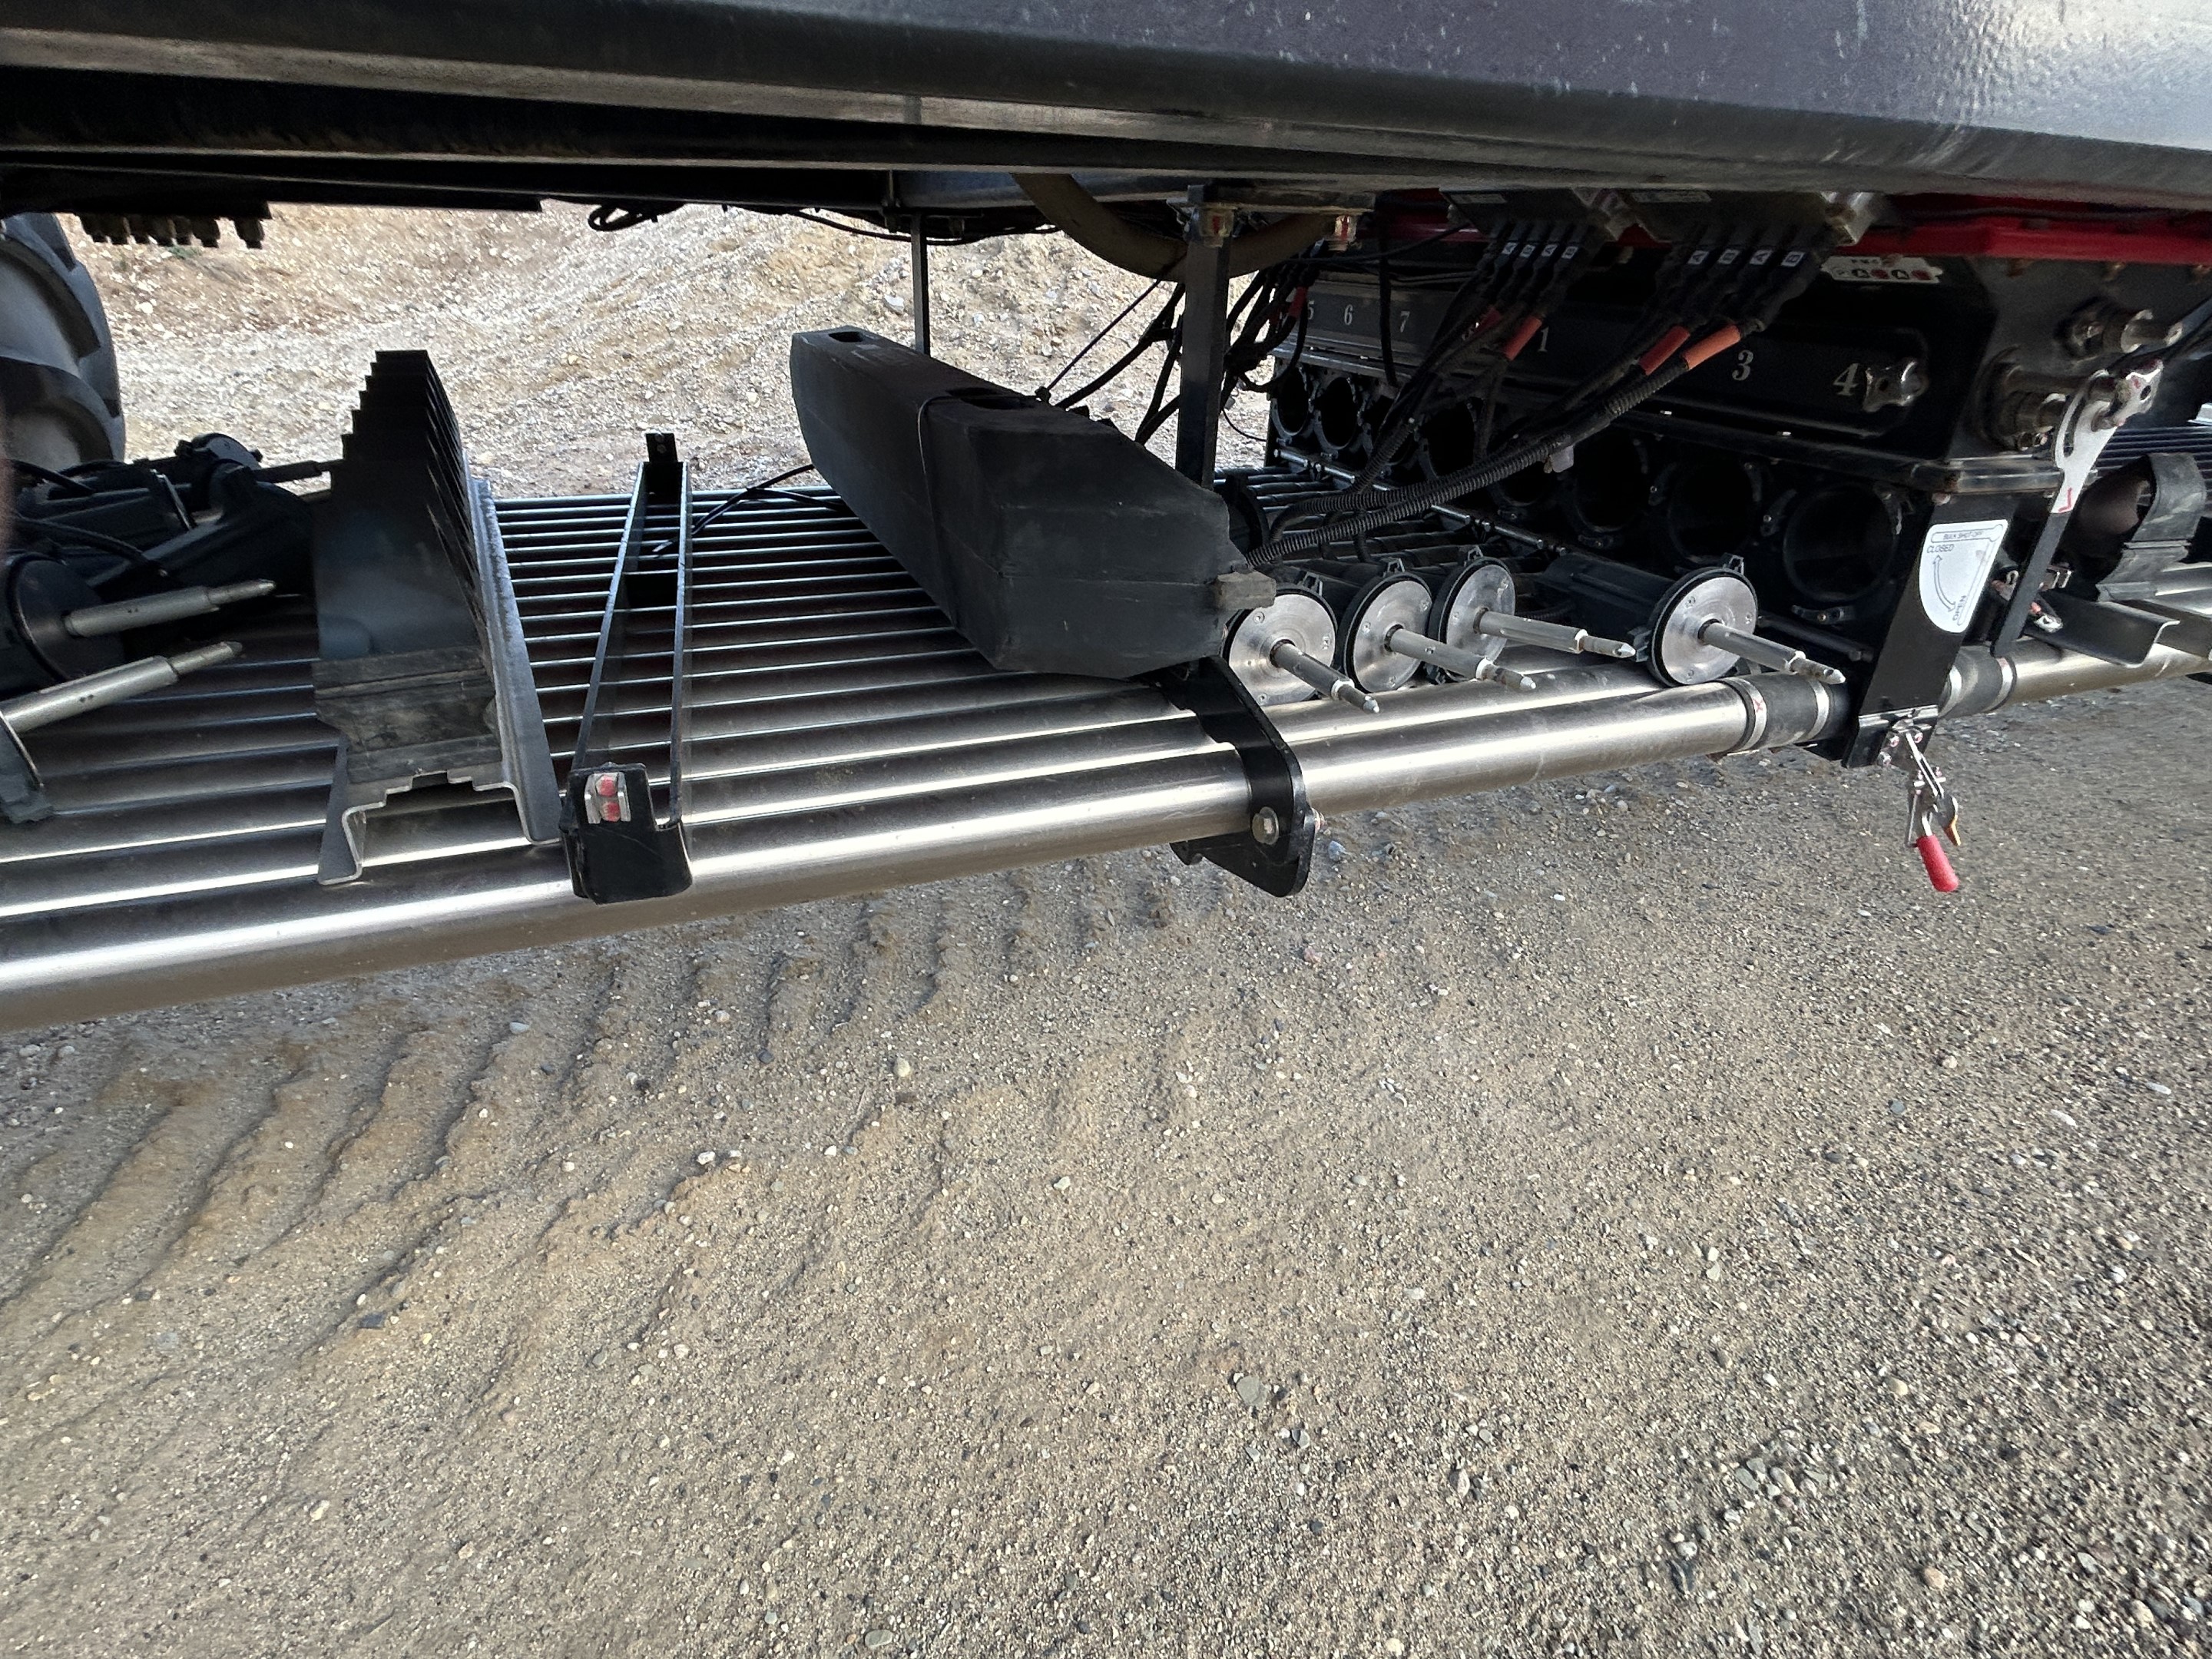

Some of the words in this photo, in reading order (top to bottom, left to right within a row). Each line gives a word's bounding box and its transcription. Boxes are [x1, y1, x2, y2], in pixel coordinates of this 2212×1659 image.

[1343, 303, 1354, 326] 6
[1399, 310, 1411, 333] 7
[1536, 326, 1550, 353] 1
[1731, 349, 1755, 382] 3
[1832, 362, 1861, 397] 4
[1926, 543, 1955, 554] CLOSED
